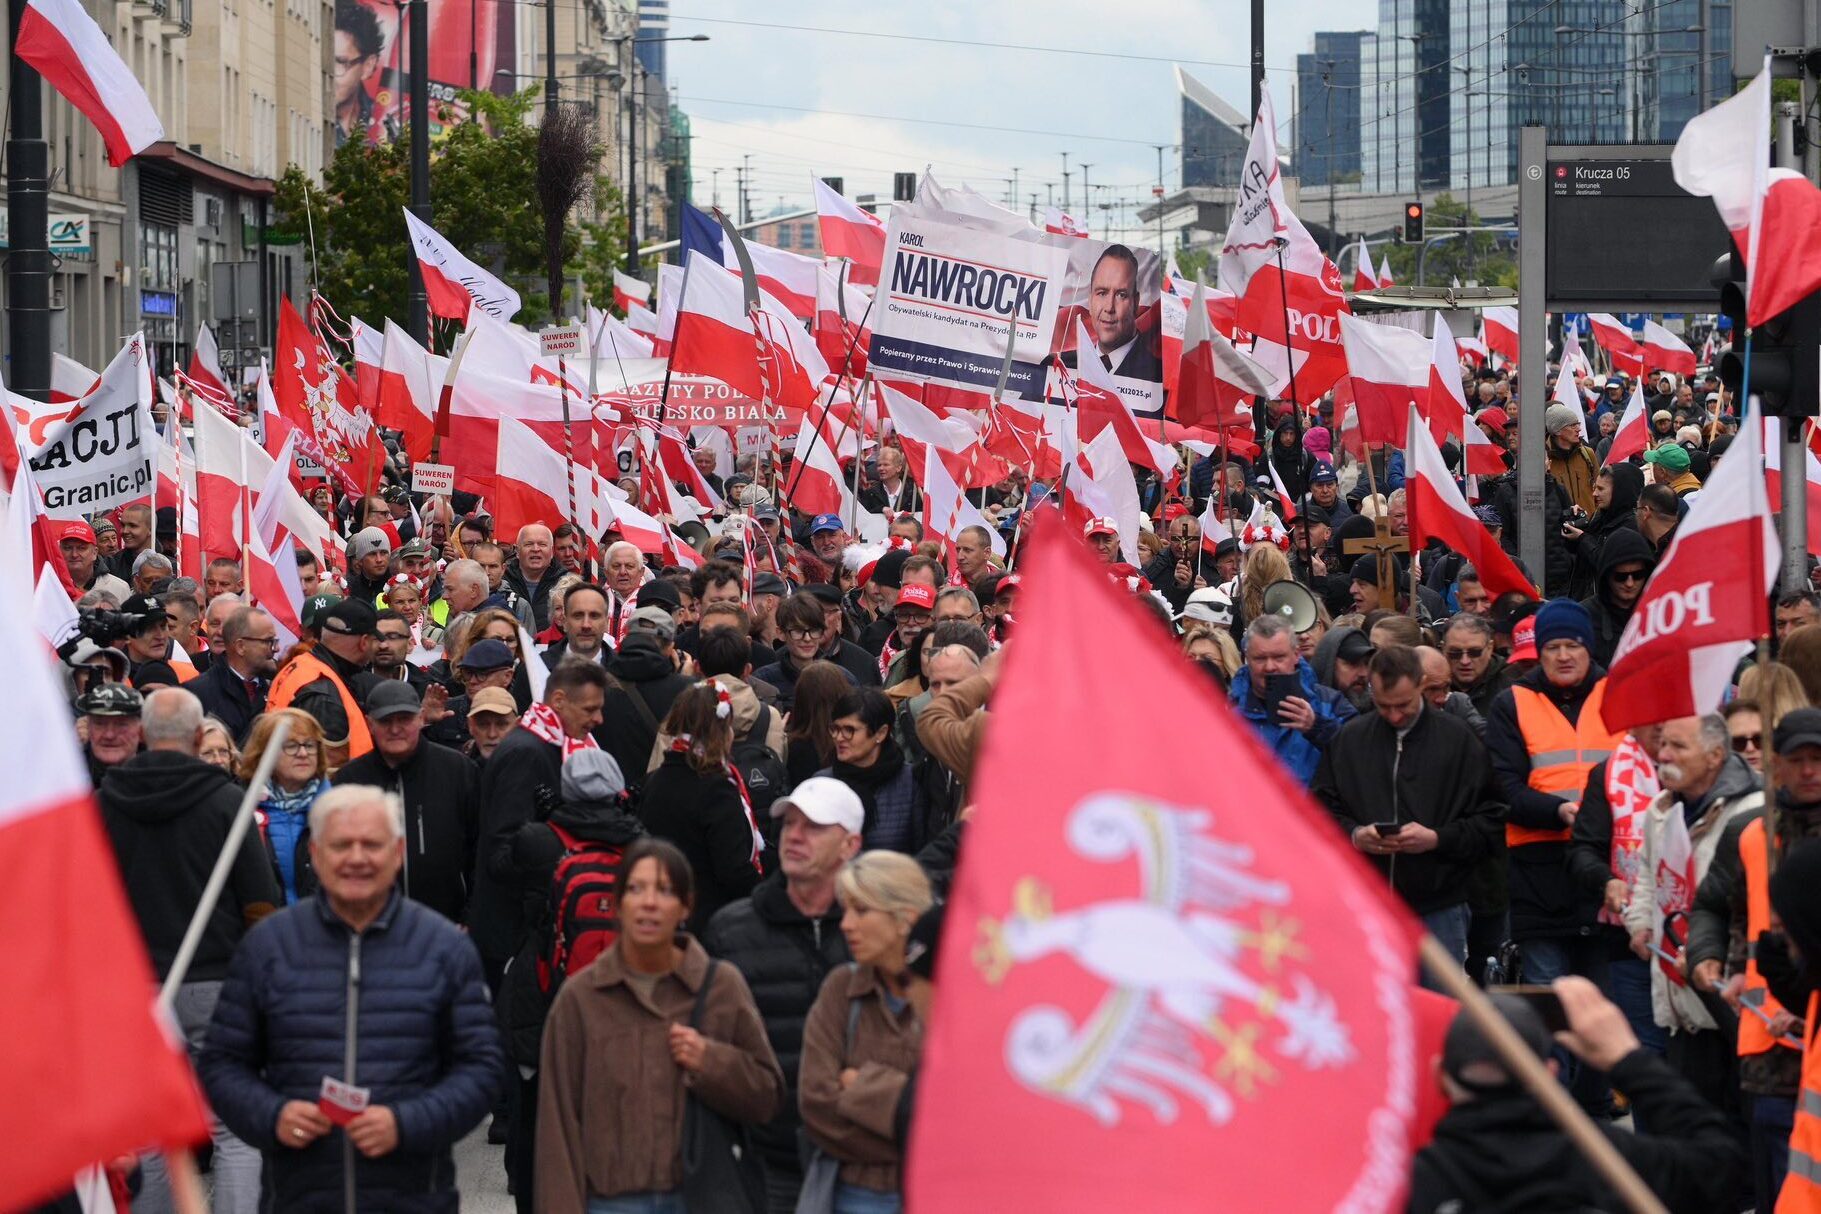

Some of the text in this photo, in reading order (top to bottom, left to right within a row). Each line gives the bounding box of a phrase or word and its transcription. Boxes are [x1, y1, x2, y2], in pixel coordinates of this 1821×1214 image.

[1575, 166, 1631, 179] Krucza 05
[900, 232, 923, 247] KAROL
[891, 251, 1047, 320] NAWROCKI
[888, 303, 1037, 340] Obywatelski kandydat na Prezydeta RP
[1286, 307, 1342, 344] POL
[541, 331, 579, 342] SUWEREN
[546, 341, 575, 350] NARÓD
[879, 346, 915, 361] Popierany
[915, 355, 937, 365] przez
[938, 357, 963, 369] Prawo
[968, 363, 1032, 381] Sprawieiwość
[703, 384, 749, 399] POL
[747, 434, 766, 445] MY
[414, 469, 452, 479] SUWEREN
[418, 478, 447, 489] NARÓD
